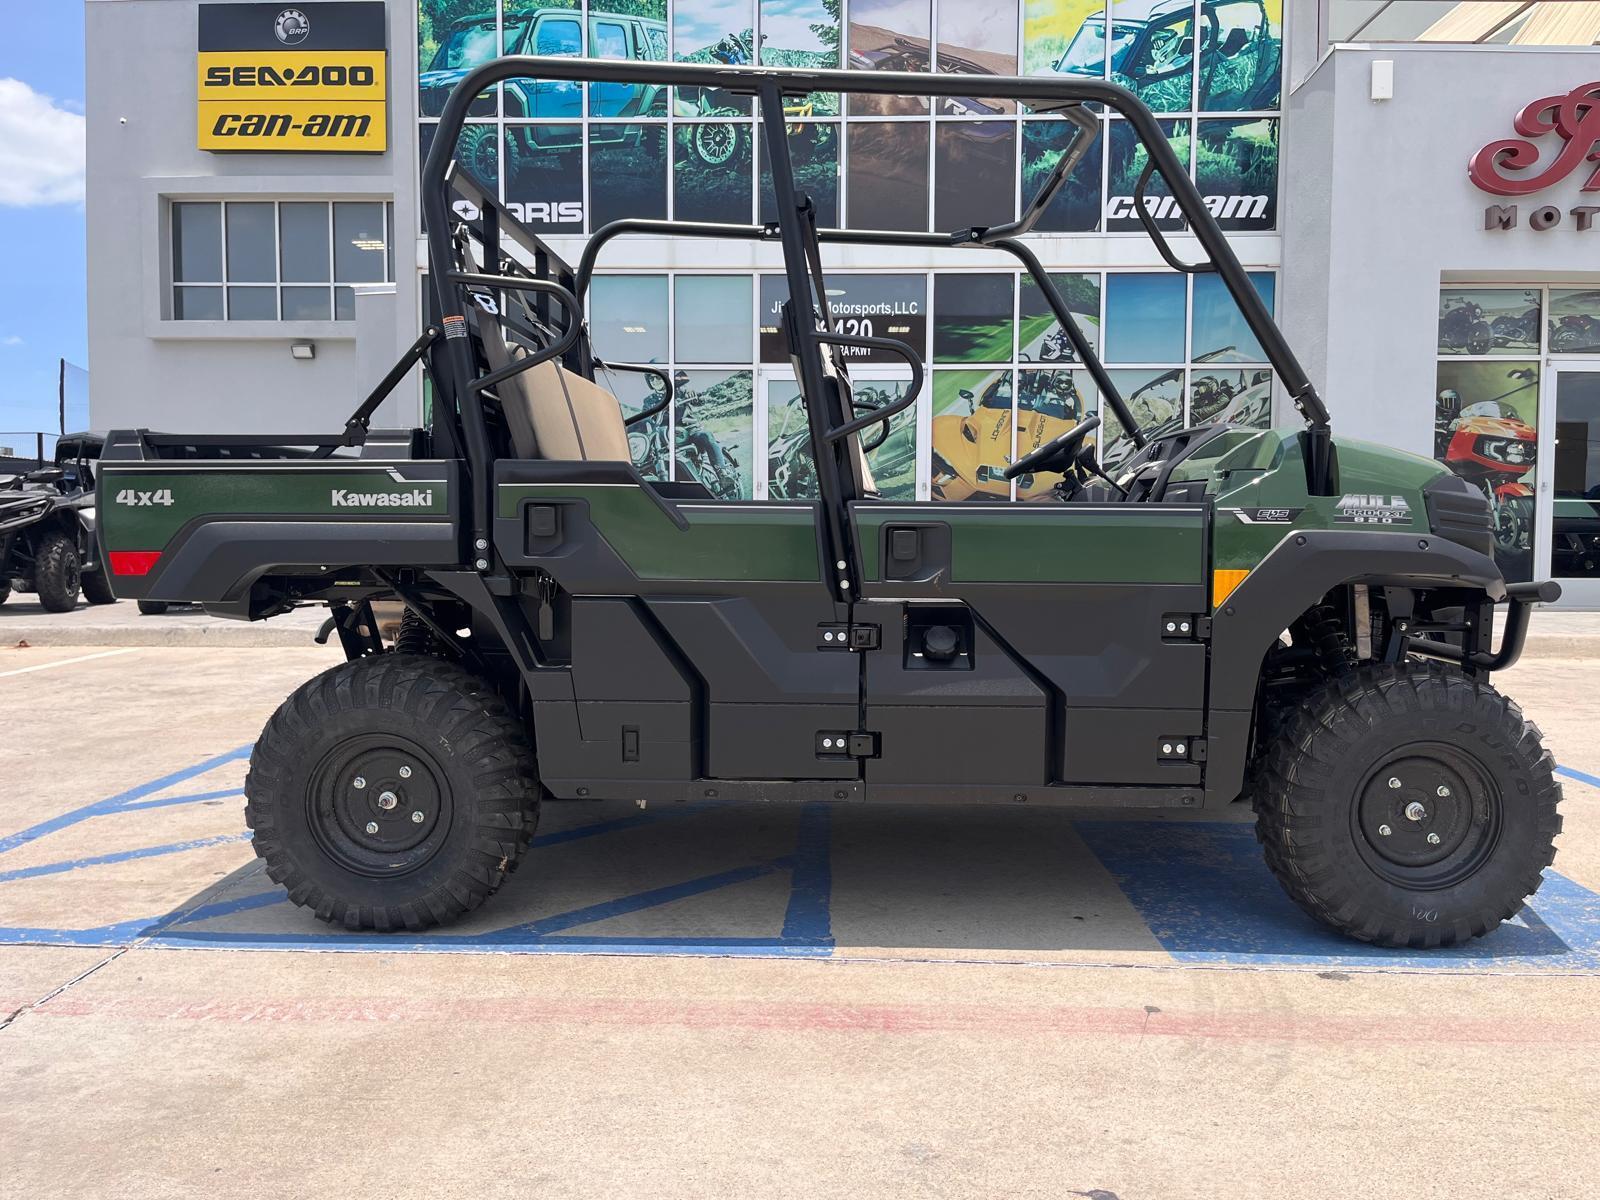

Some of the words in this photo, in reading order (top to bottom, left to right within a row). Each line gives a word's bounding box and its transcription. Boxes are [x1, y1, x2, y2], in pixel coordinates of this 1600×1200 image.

[1106, 195, 1269, 219] canam
[116, 489, 174, 506] 4x4
[331, 489, 433, 506] Kawasaki
[1335, 494, 1412, 511] MULE
